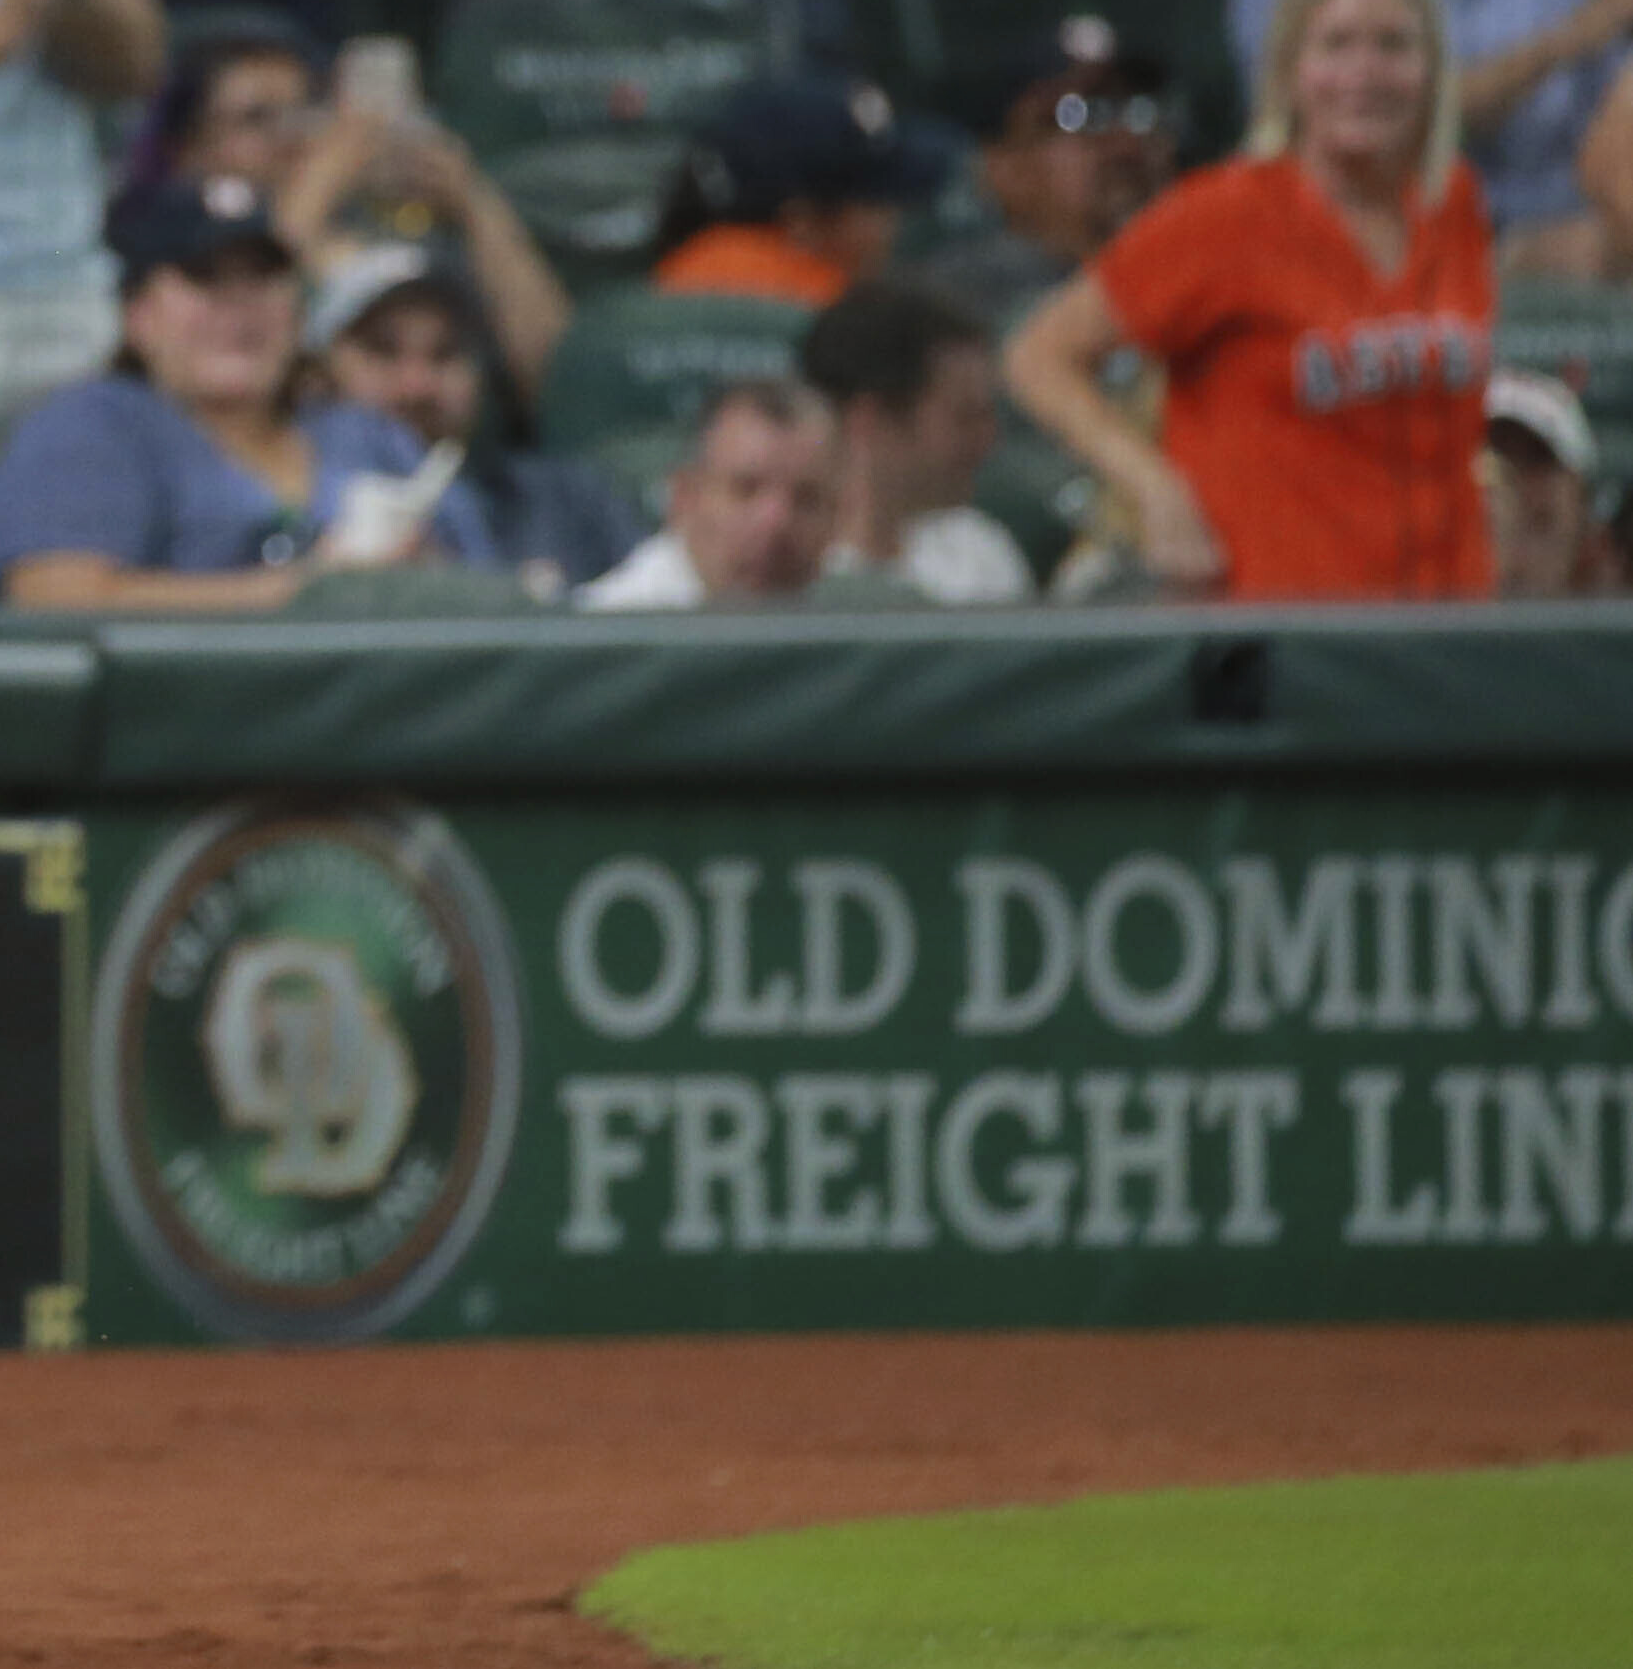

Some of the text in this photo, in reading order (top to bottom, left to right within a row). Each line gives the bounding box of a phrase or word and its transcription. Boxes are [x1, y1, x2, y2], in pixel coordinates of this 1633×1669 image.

[555, 855, 920, 1042] OLD
[952, 849, 1633, 1038] DOMINI
[557, 1064, 1633, 1255] FREIGHT LIN
